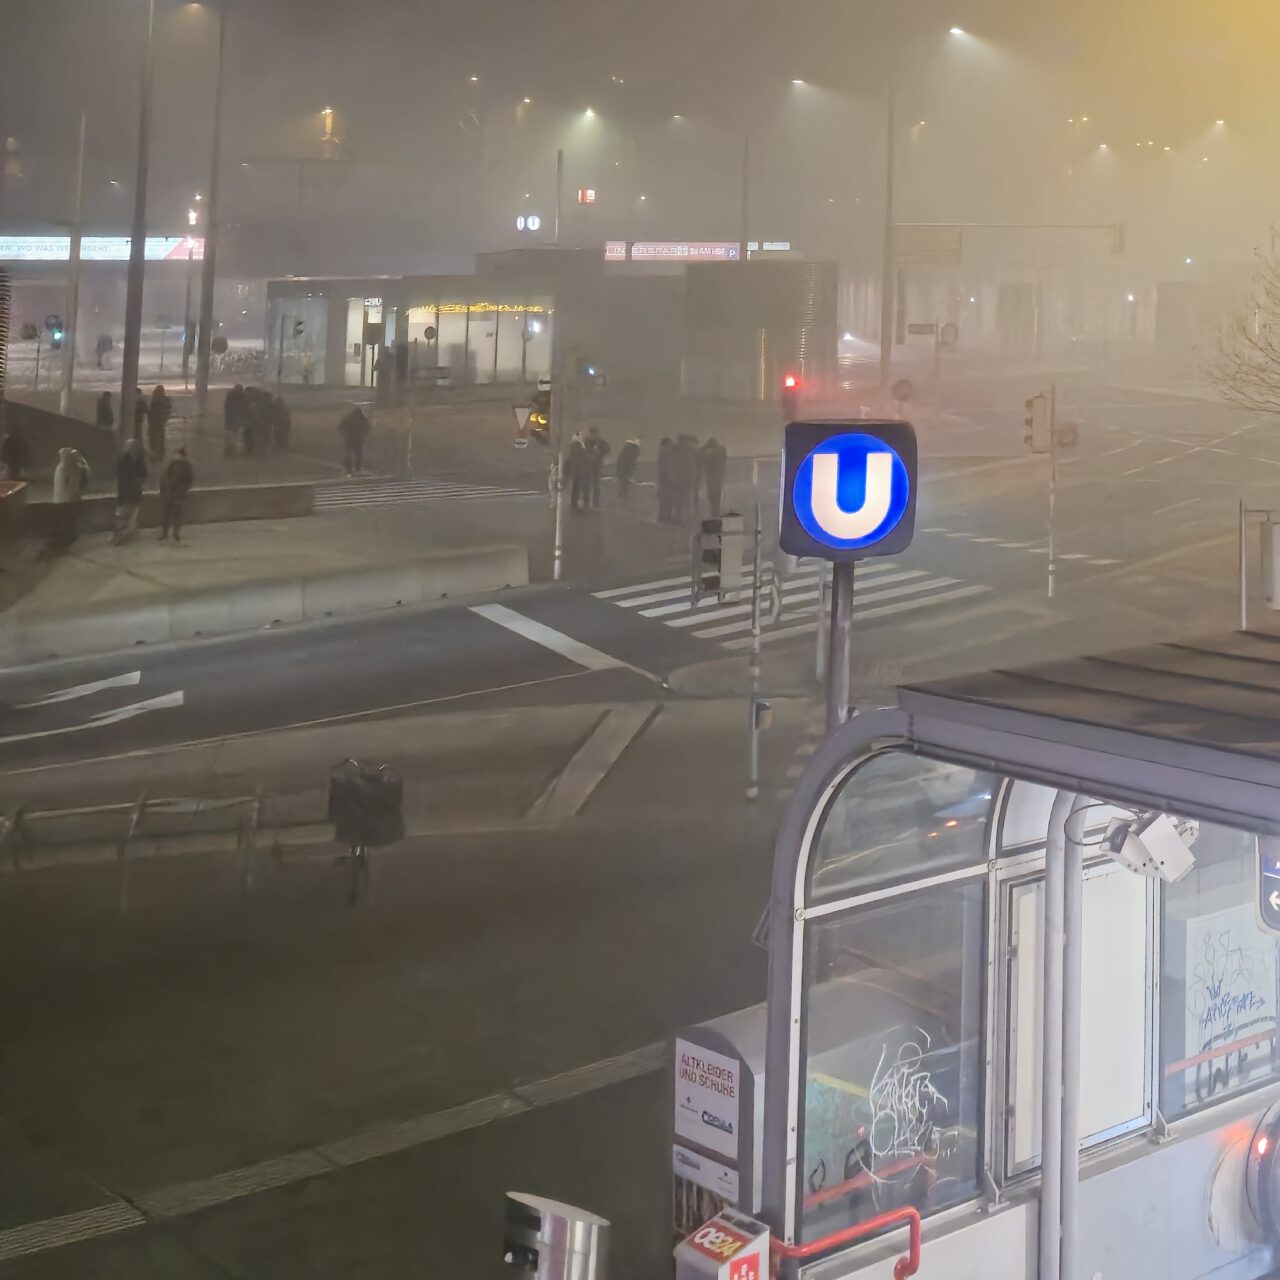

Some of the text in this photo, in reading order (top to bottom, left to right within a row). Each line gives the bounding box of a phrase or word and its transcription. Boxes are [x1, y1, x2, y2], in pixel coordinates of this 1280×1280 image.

[613, 246, 677, 255] INERSPAR
[811, 452, 892, 539] U
[680, 1067, 736, 1099] UND SCHUHE
[681, 1053, 734, 1083] ALTKLEIDER
